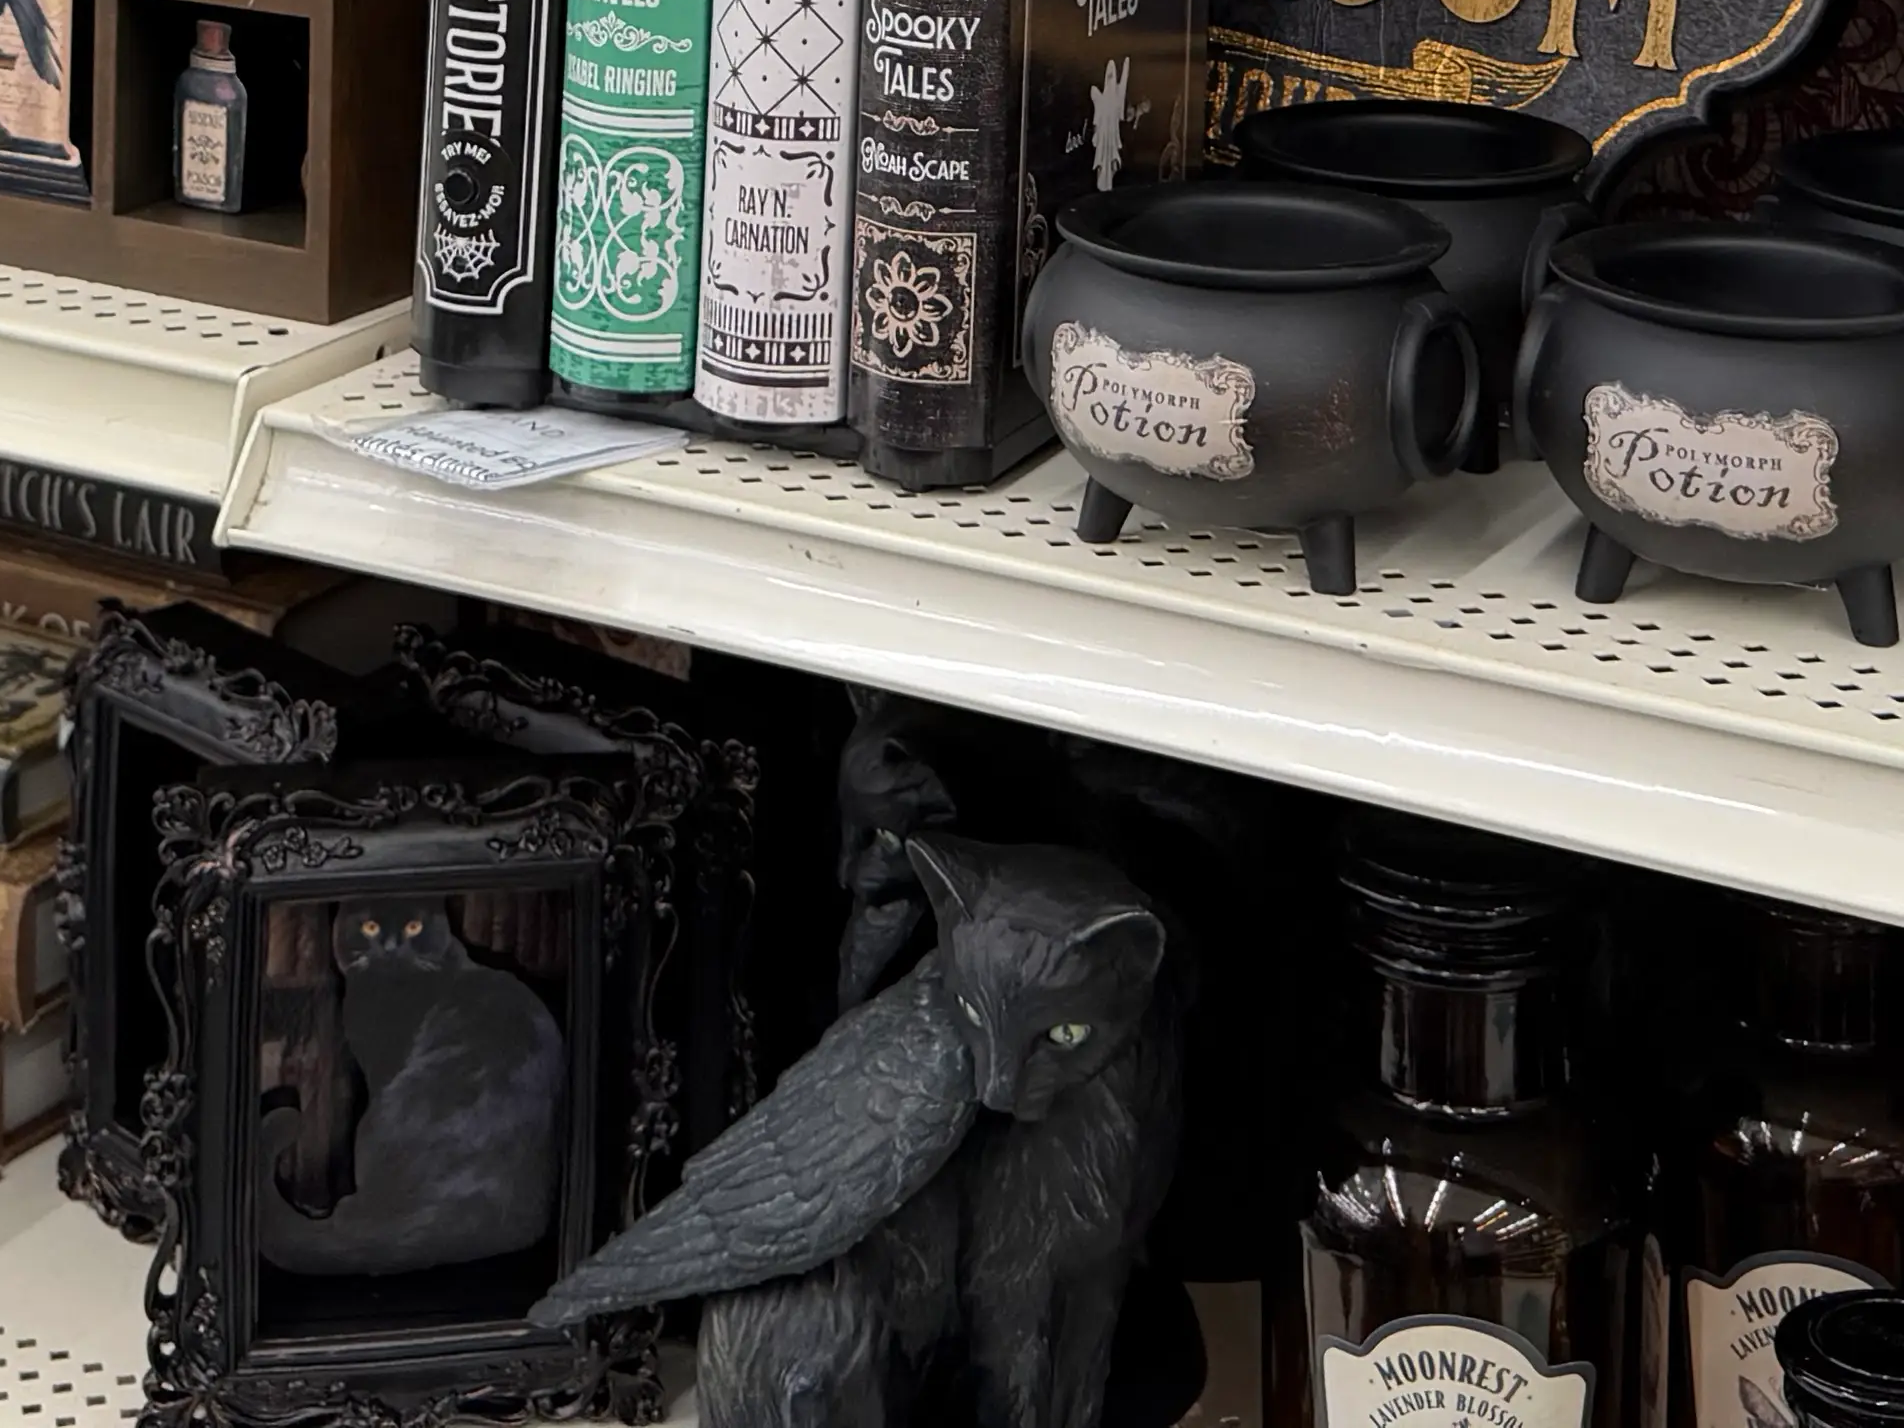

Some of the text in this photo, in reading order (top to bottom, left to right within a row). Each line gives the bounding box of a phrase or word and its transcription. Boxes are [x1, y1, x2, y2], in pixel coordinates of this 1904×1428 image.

[604, 65, 678, 97] RINGING
[440, 141, 492, 165] TRY ME!
[909, 152, 970, 182] SCAPE
[738, 185, 792, 219] RAY N.
[725, 217, 810, 254] CARNATION
[1061, 362, 1208, 448] Potion
[1102, 378, 1201, 410] POLYMORPH
[1604, 427, 1791, 508] Potion
[1665, 444, 1783, 471] POLYMORPH
[113, 491, 196, 564] LAIR
[1373, 1350, 1528, 1404] MOONREST
[1369, 1390, 1524, 1428] LAVENDER BLOSSO
